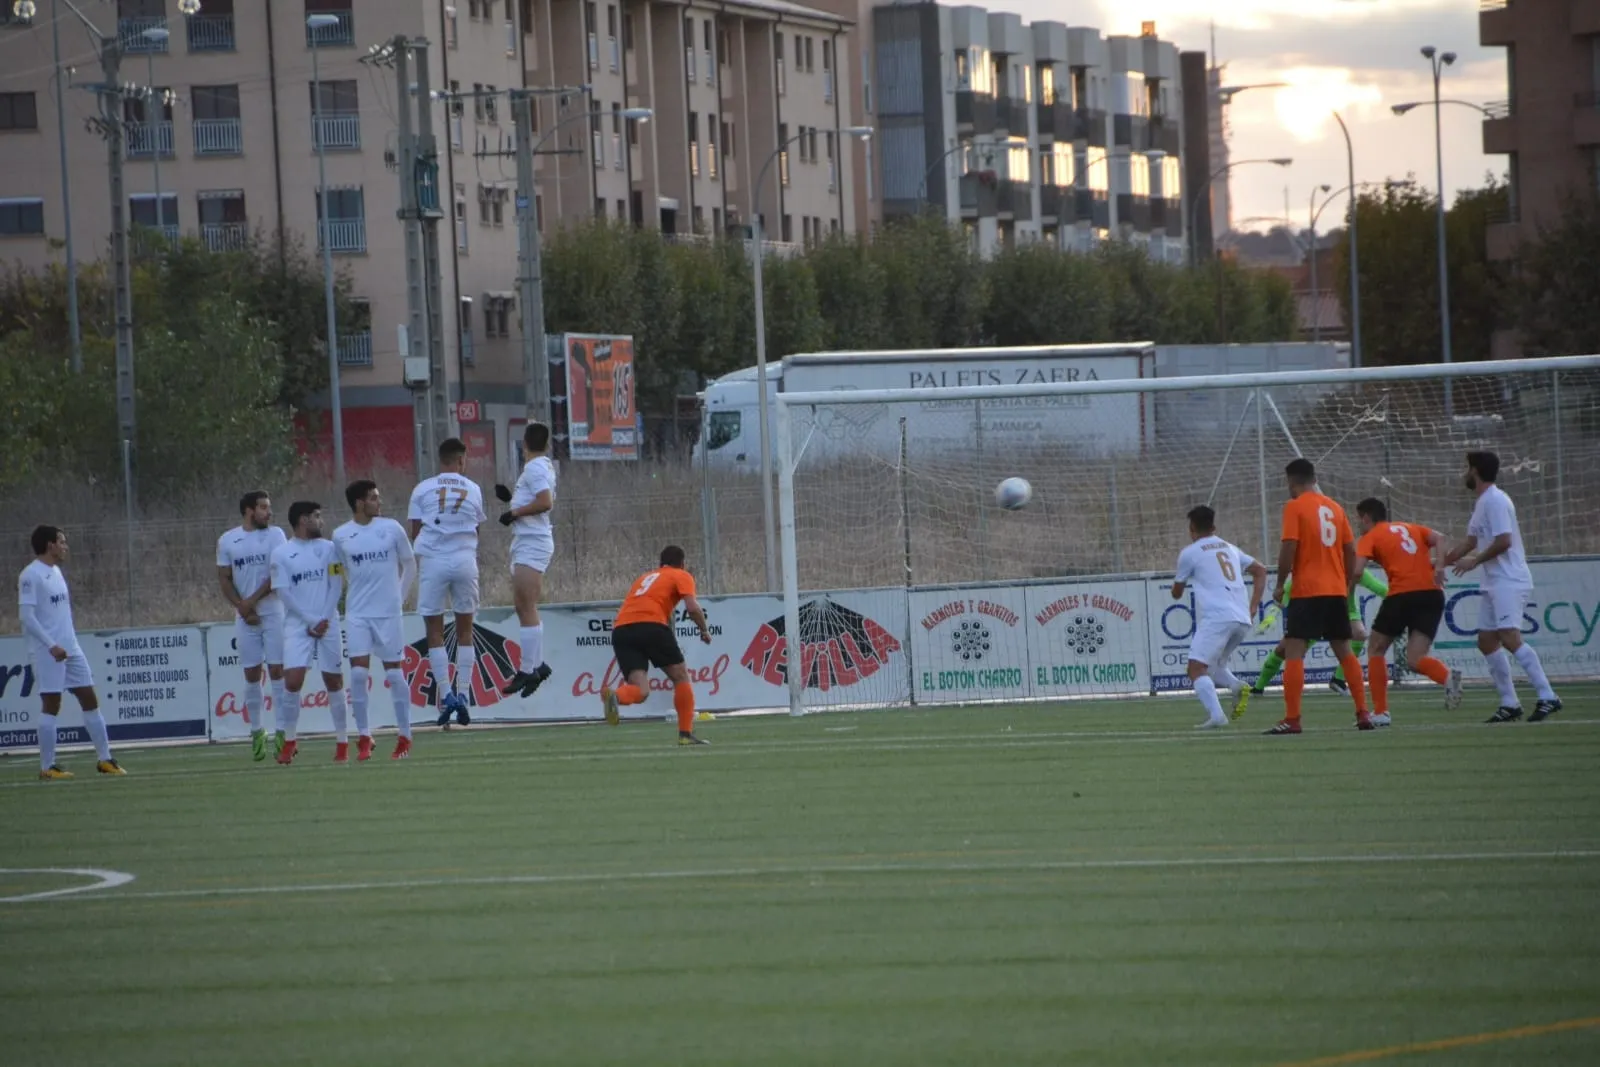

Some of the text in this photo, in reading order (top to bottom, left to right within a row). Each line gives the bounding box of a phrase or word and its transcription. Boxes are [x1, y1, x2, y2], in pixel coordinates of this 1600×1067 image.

[435, 487, 468, 514] 17
[1318, 506, 1337, 547] 6
[1389, 524, 1418, 554] 3
[1215, 551, 1236, 582] 6
[635, 572, 660, 596] 9
[150, 636, 160, 648] DE
[116, 653, 169, 667] DETERGENTES
[118, 671, 152, 685] JABONES
[923, 672, 936, 690] EL
[979, 668, 1022, 689] CHARRO
[1036, 667, 1049, 685] EL
[1092, 663, 1136, 683] CHARRO
[118, 687, 176, 701] PRODUCTOS DE
[118, 705, 154, 719] PISCINAS
